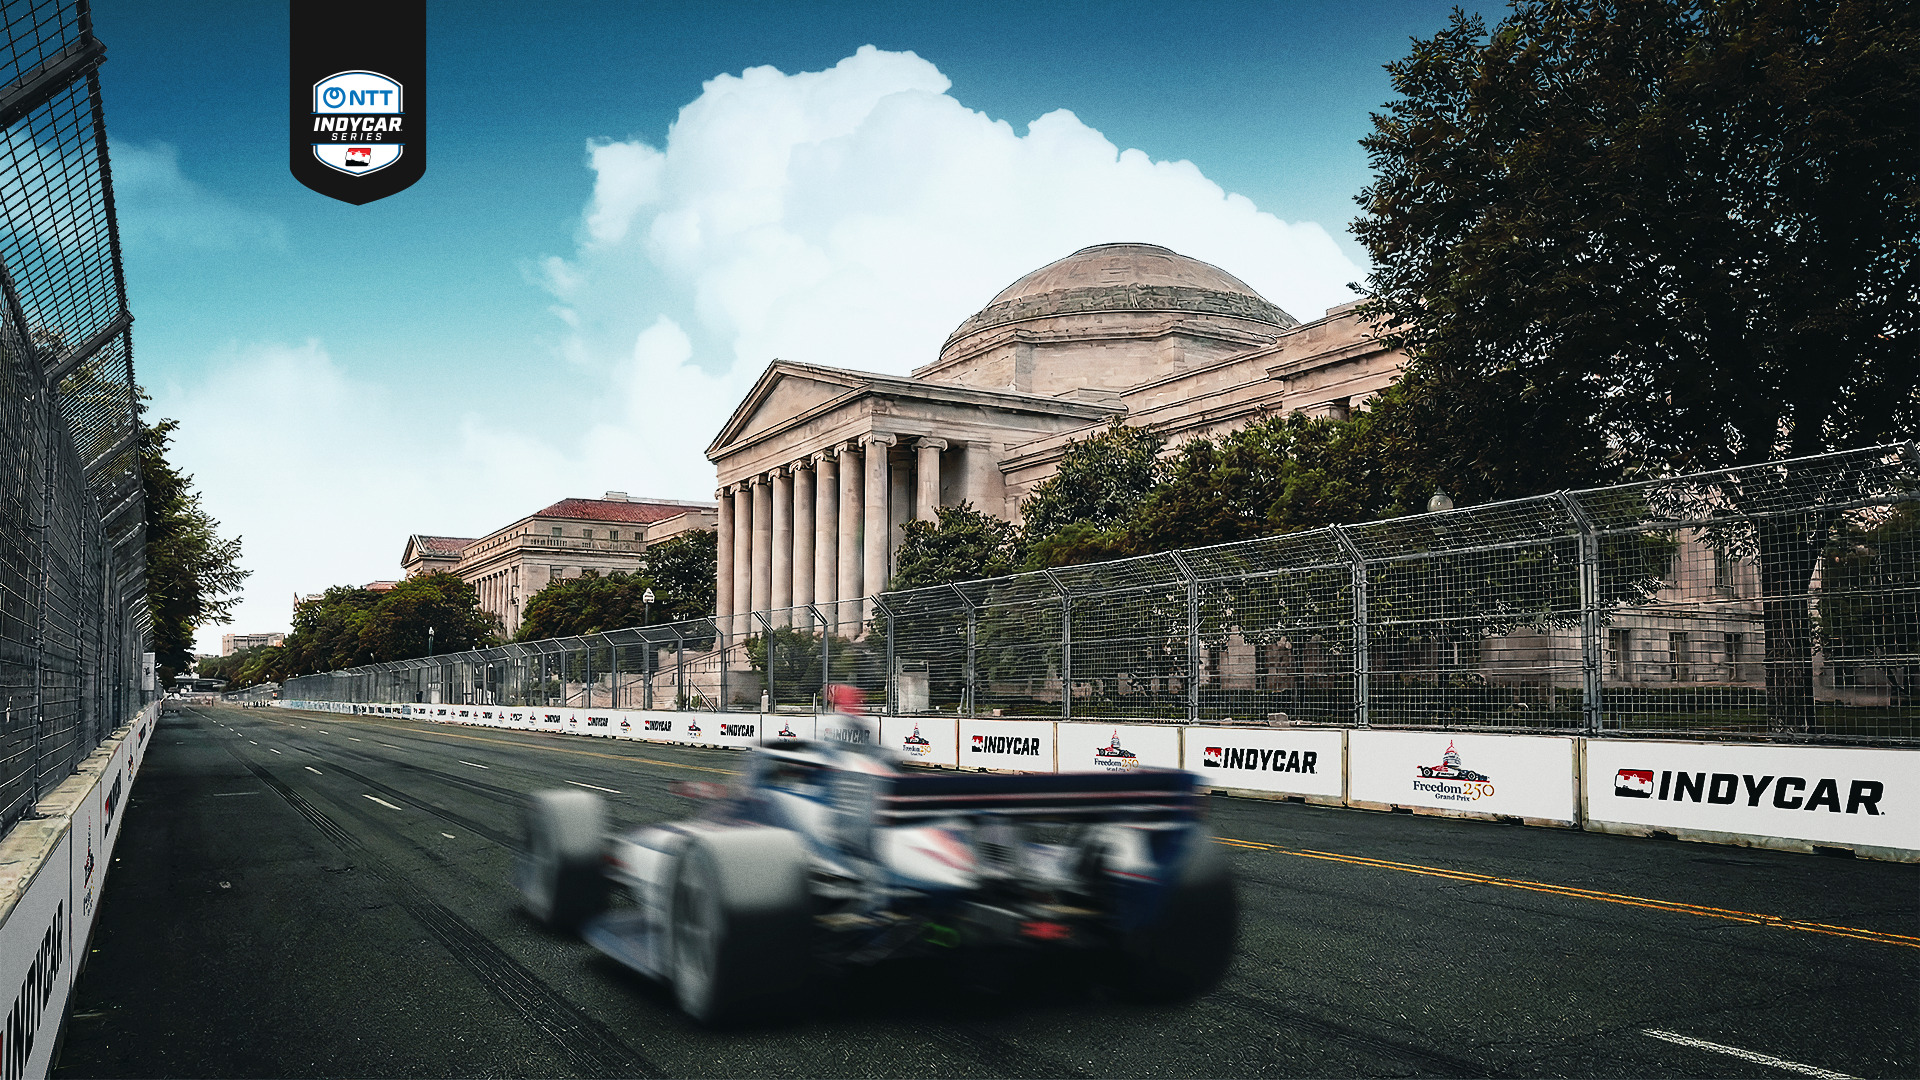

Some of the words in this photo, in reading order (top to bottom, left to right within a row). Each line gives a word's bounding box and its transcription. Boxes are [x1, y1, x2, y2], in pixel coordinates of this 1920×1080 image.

[727, 725, 754, 737] INDYCAR
[984, 736, 1039, 755] INDYCAR
[1223, 748, 1318, 774] INDYCAR
[1435, 793, 1455, 801] Grand
[1658, 771, 1885, 815] INDYCAR
